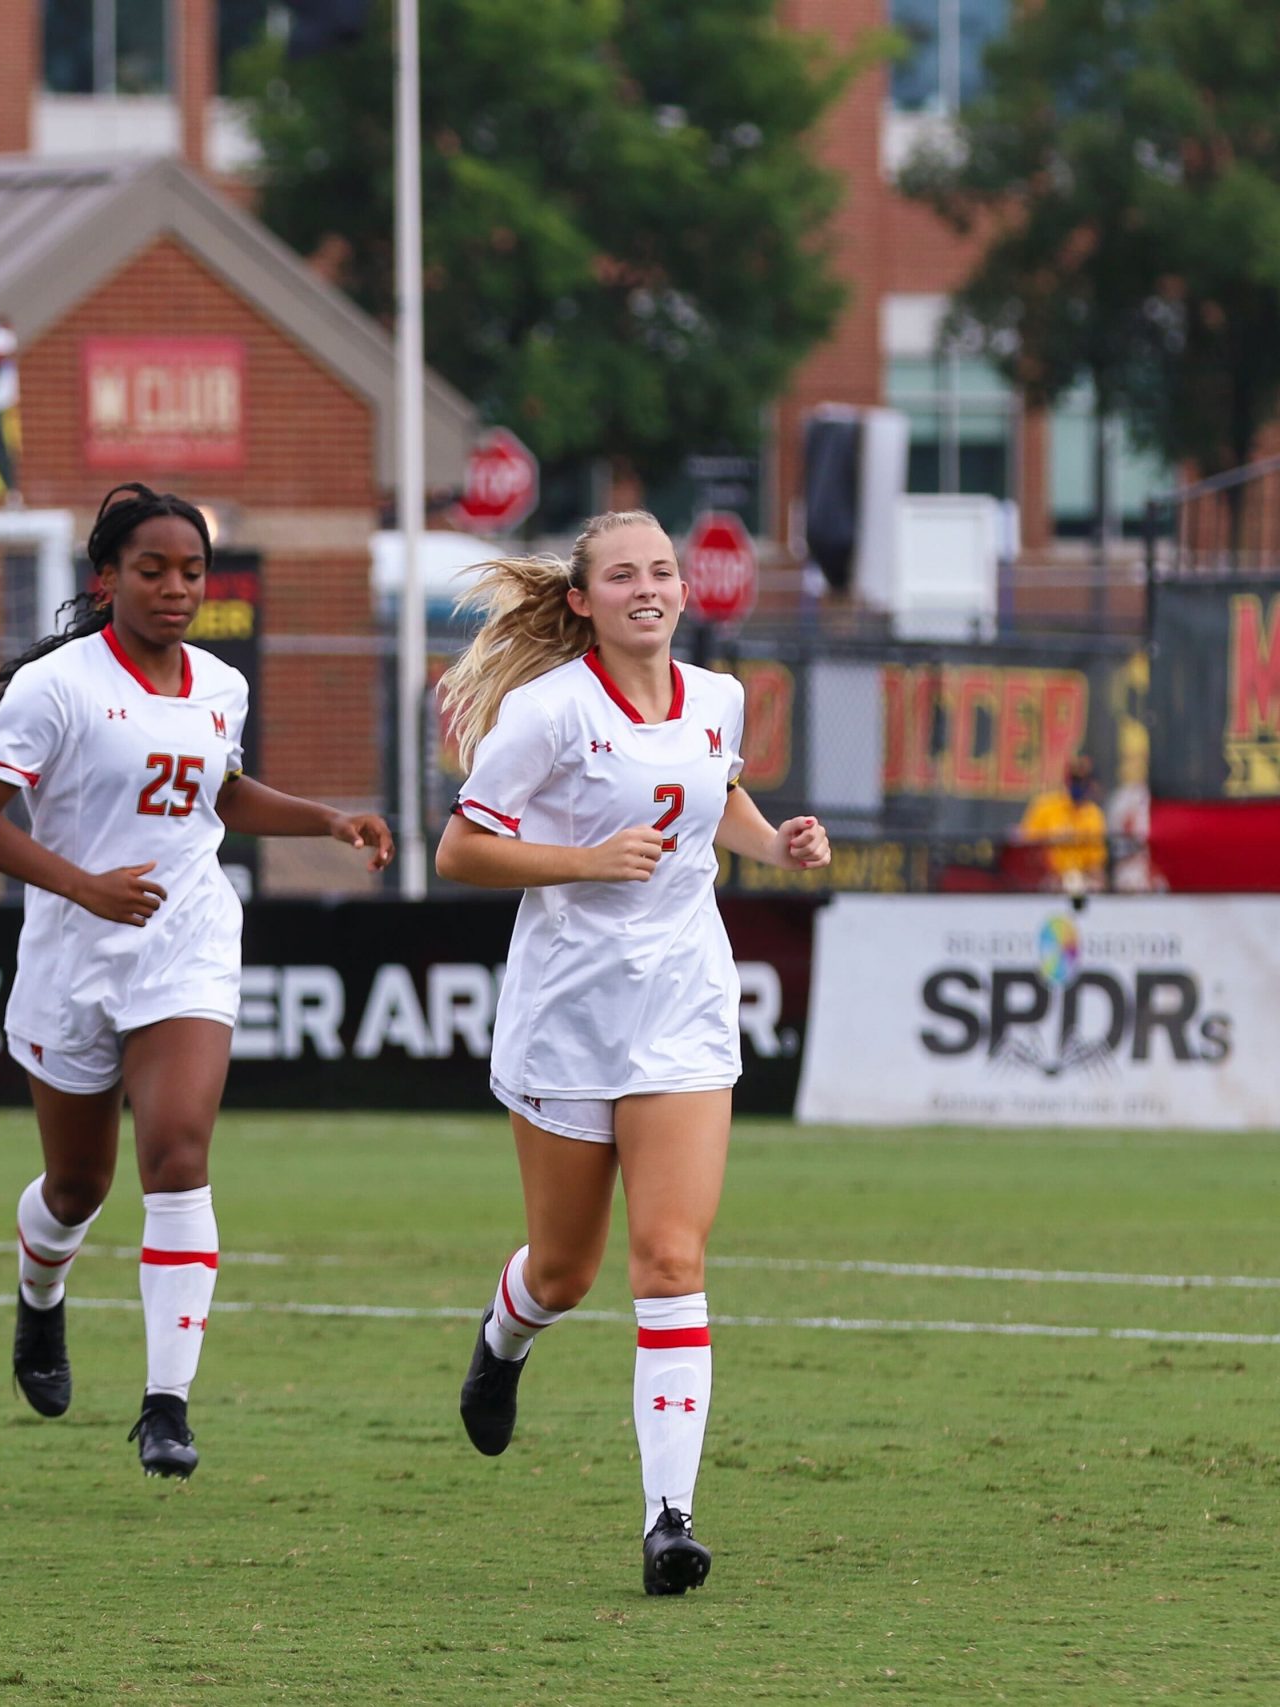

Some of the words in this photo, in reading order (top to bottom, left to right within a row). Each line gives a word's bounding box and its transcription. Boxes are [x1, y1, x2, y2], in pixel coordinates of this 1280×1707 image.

[690, 551, 753, 599] STOP
[137, 752, 204, 816] 25
[652, 784, 684, 852] 2
